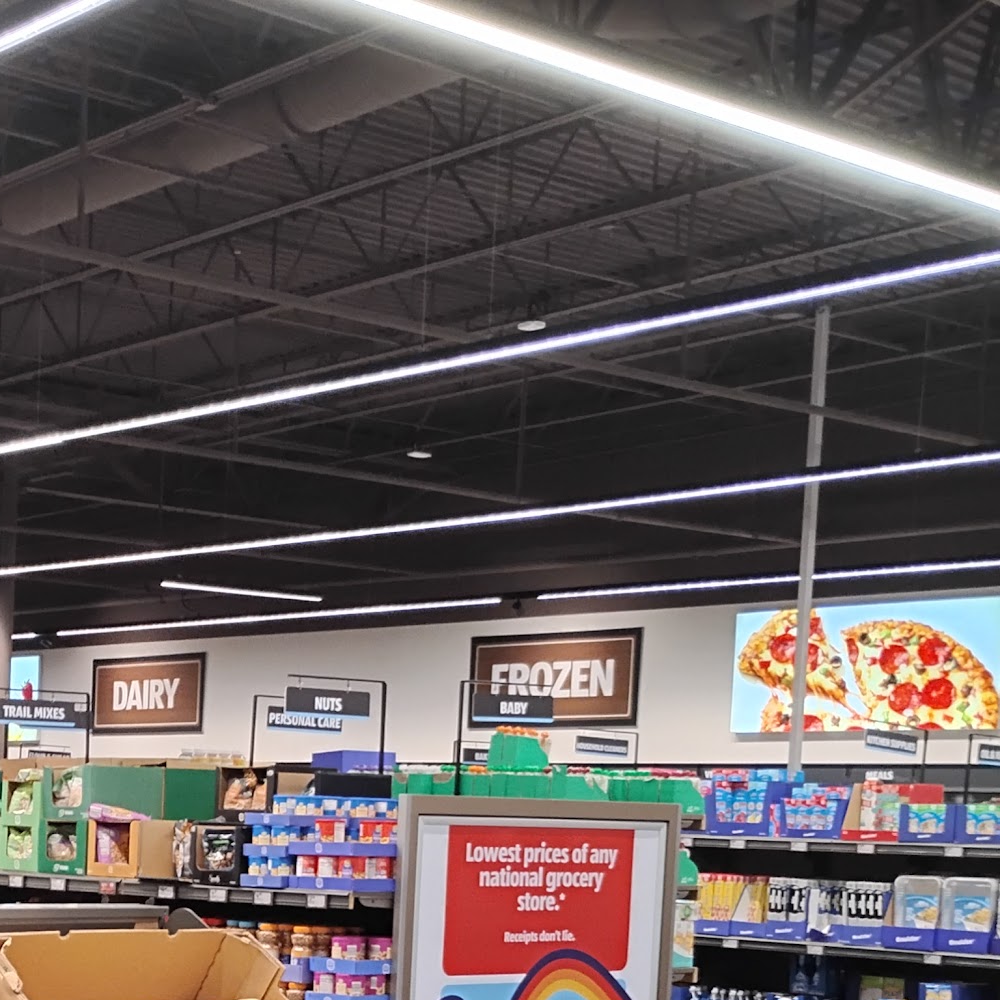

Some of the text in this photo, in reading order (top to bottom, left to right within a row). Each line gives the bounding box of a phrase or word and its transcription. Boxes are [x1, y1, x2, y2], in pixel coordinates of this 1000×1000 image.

[490, 658, 615, 698] FROZEN
[112, 678, 180, 712] DAIRY
[3, 704, 65, 720] TRAIL MIXES
[314, 696, 342, 712] NUTS
[500, 701, 528, 715] BABY
[268, 712, 341, 729] PERSONAL CARE
[865, 770, 894, 780] MEALS
[465, 842, 618, 869] Lowest prices of any
[479, 866, 604, 892] national grocery
[504, 930, 576, 945] Receipts don't lie.
